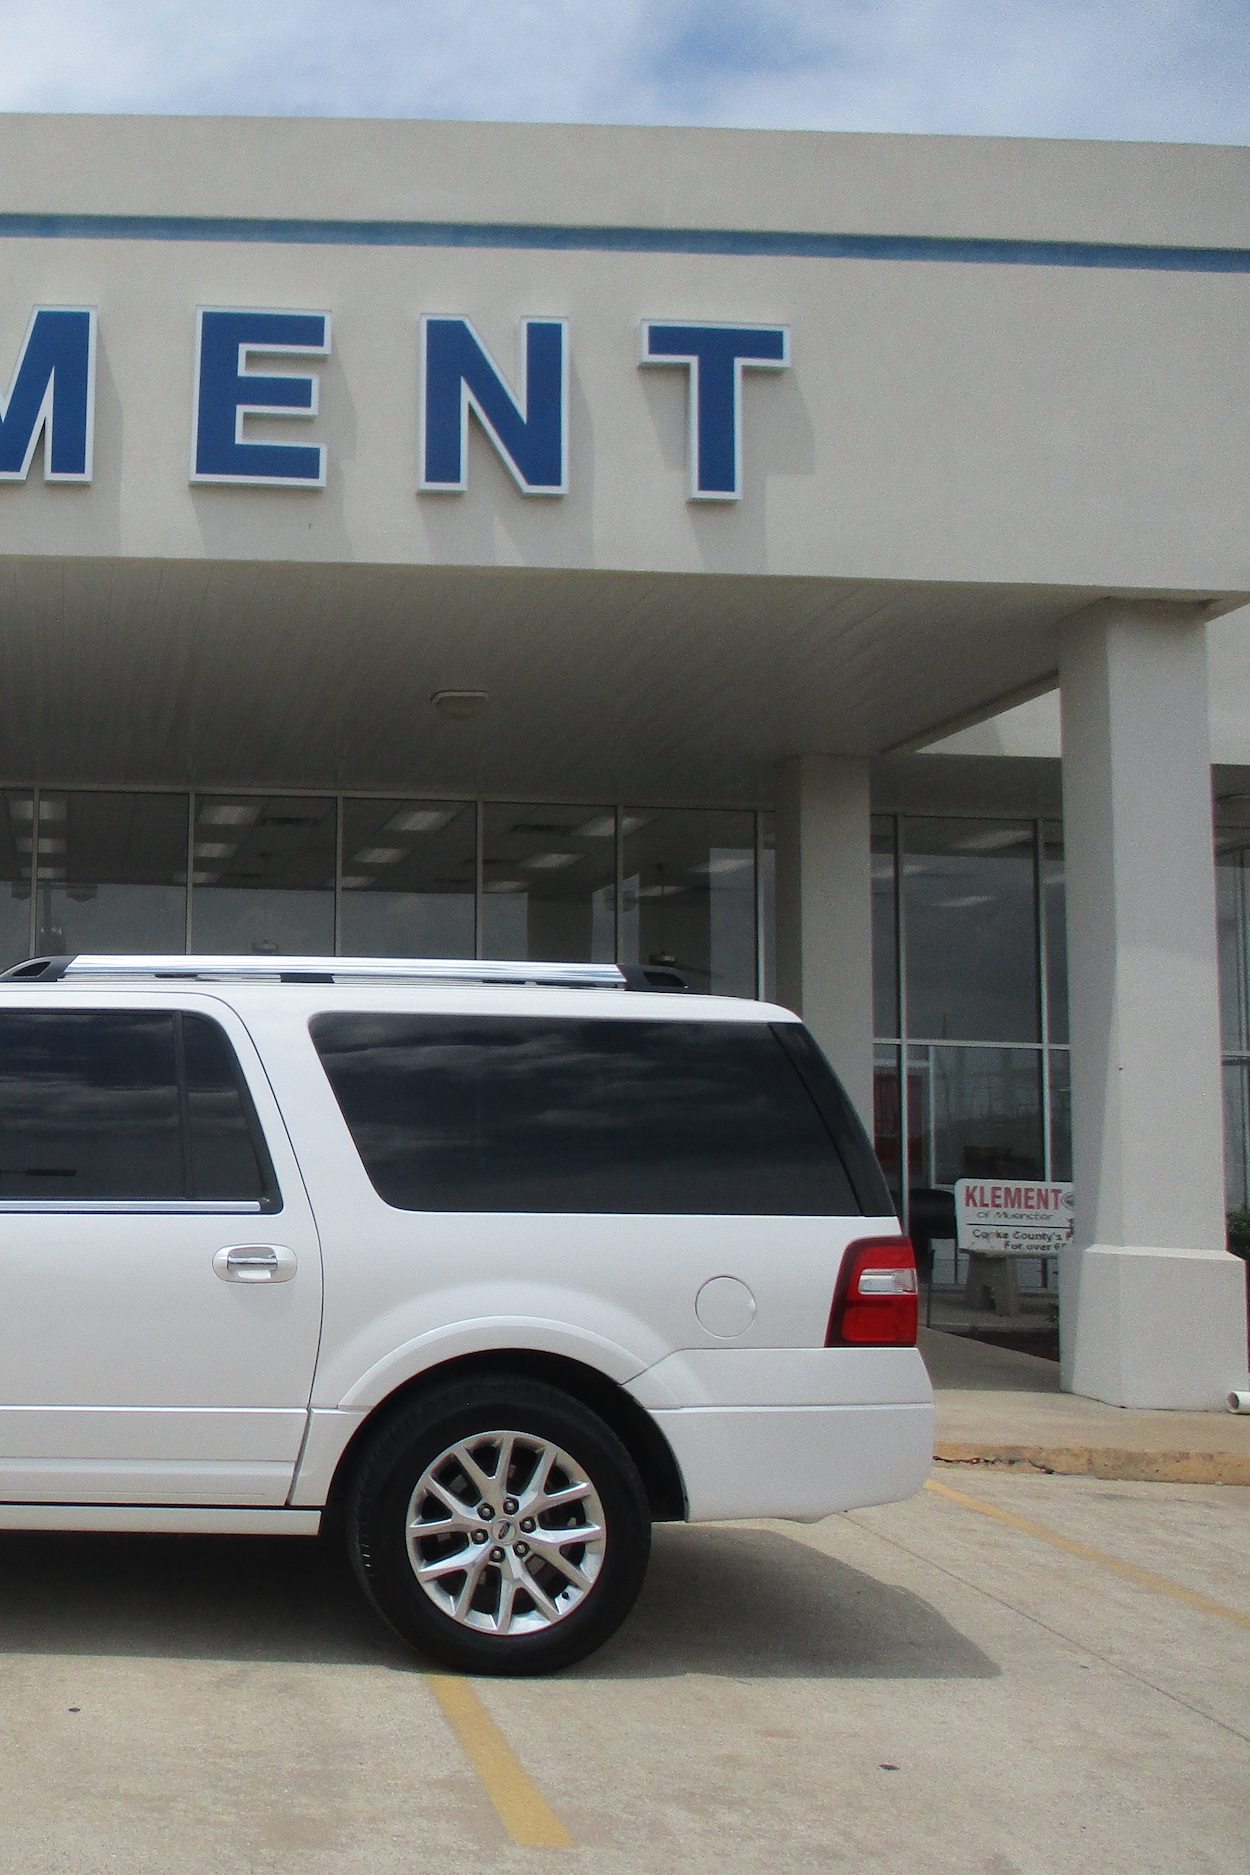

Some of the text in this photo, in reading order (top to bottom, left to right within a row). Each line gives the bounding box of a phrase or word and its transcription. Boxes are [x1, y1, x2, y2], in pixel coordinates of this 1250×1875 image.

[964, 1185, 1062, 1210] KLEMENT
[1012, 1231, 1062, 1242] County's
[1004, 1240, 1023, 1250] For
[1025, 1242, 1051, 1251] over
